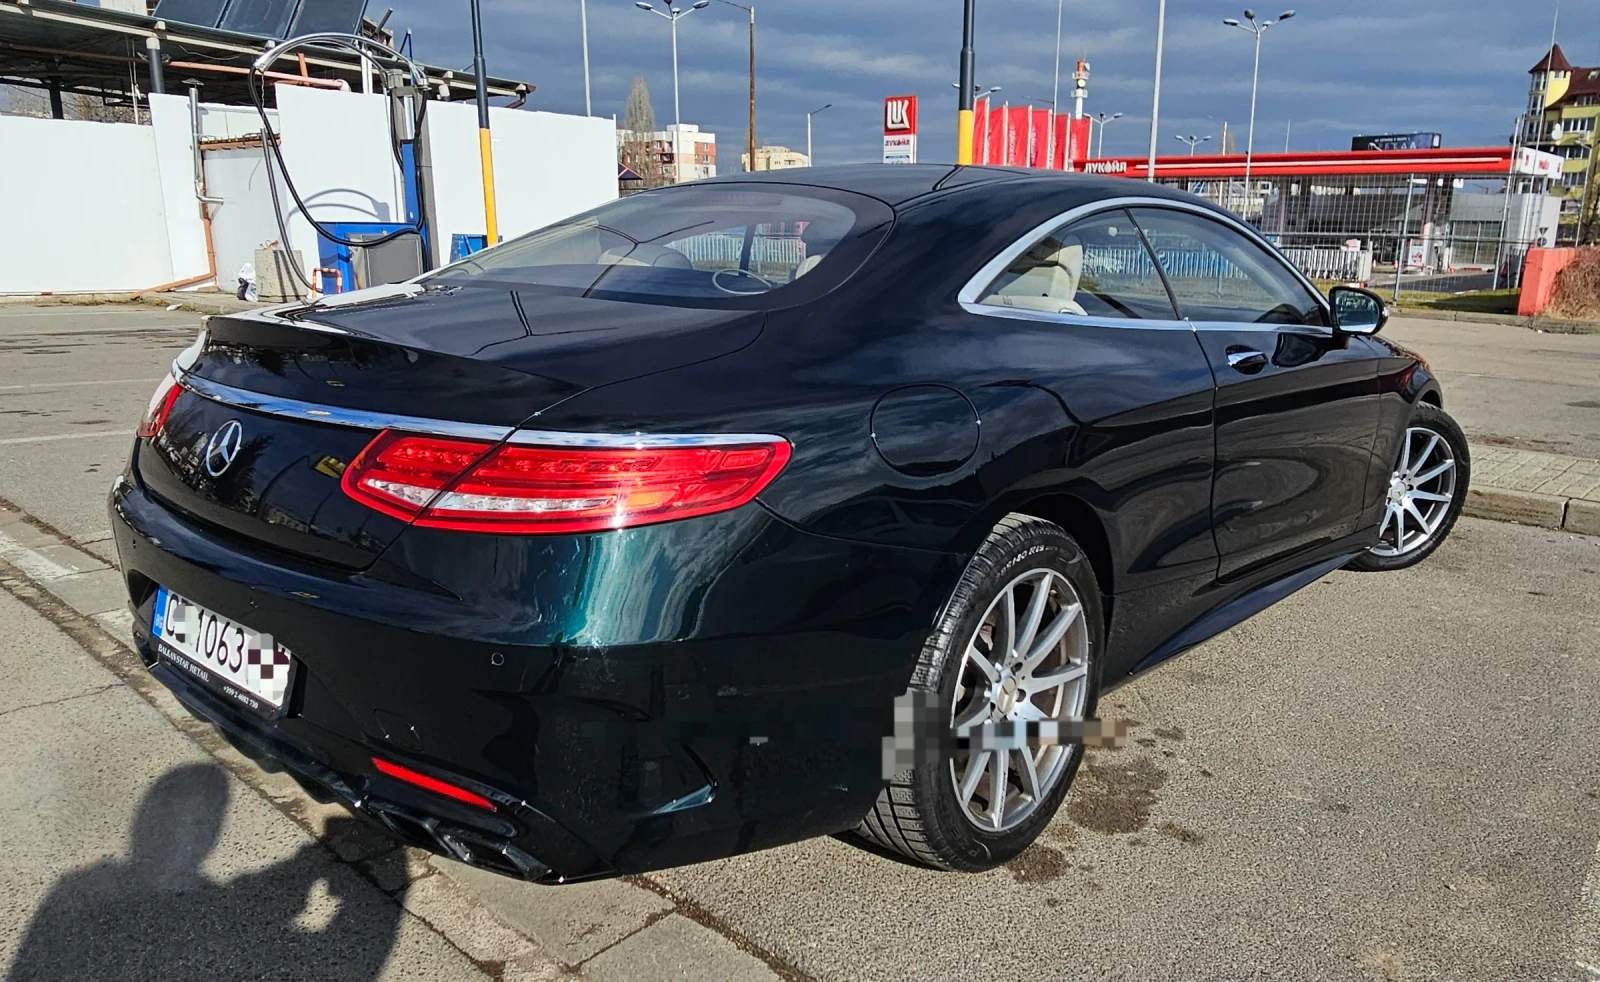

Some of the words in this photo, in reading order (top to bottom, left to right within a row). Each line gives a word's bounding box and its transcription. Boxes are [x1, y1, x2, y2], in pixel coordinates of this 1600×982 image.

[157, 643, 176, 662] BALKAN
[175, 655, 190, 670] STAR
[189, 663, 210, 683] RETAIL
